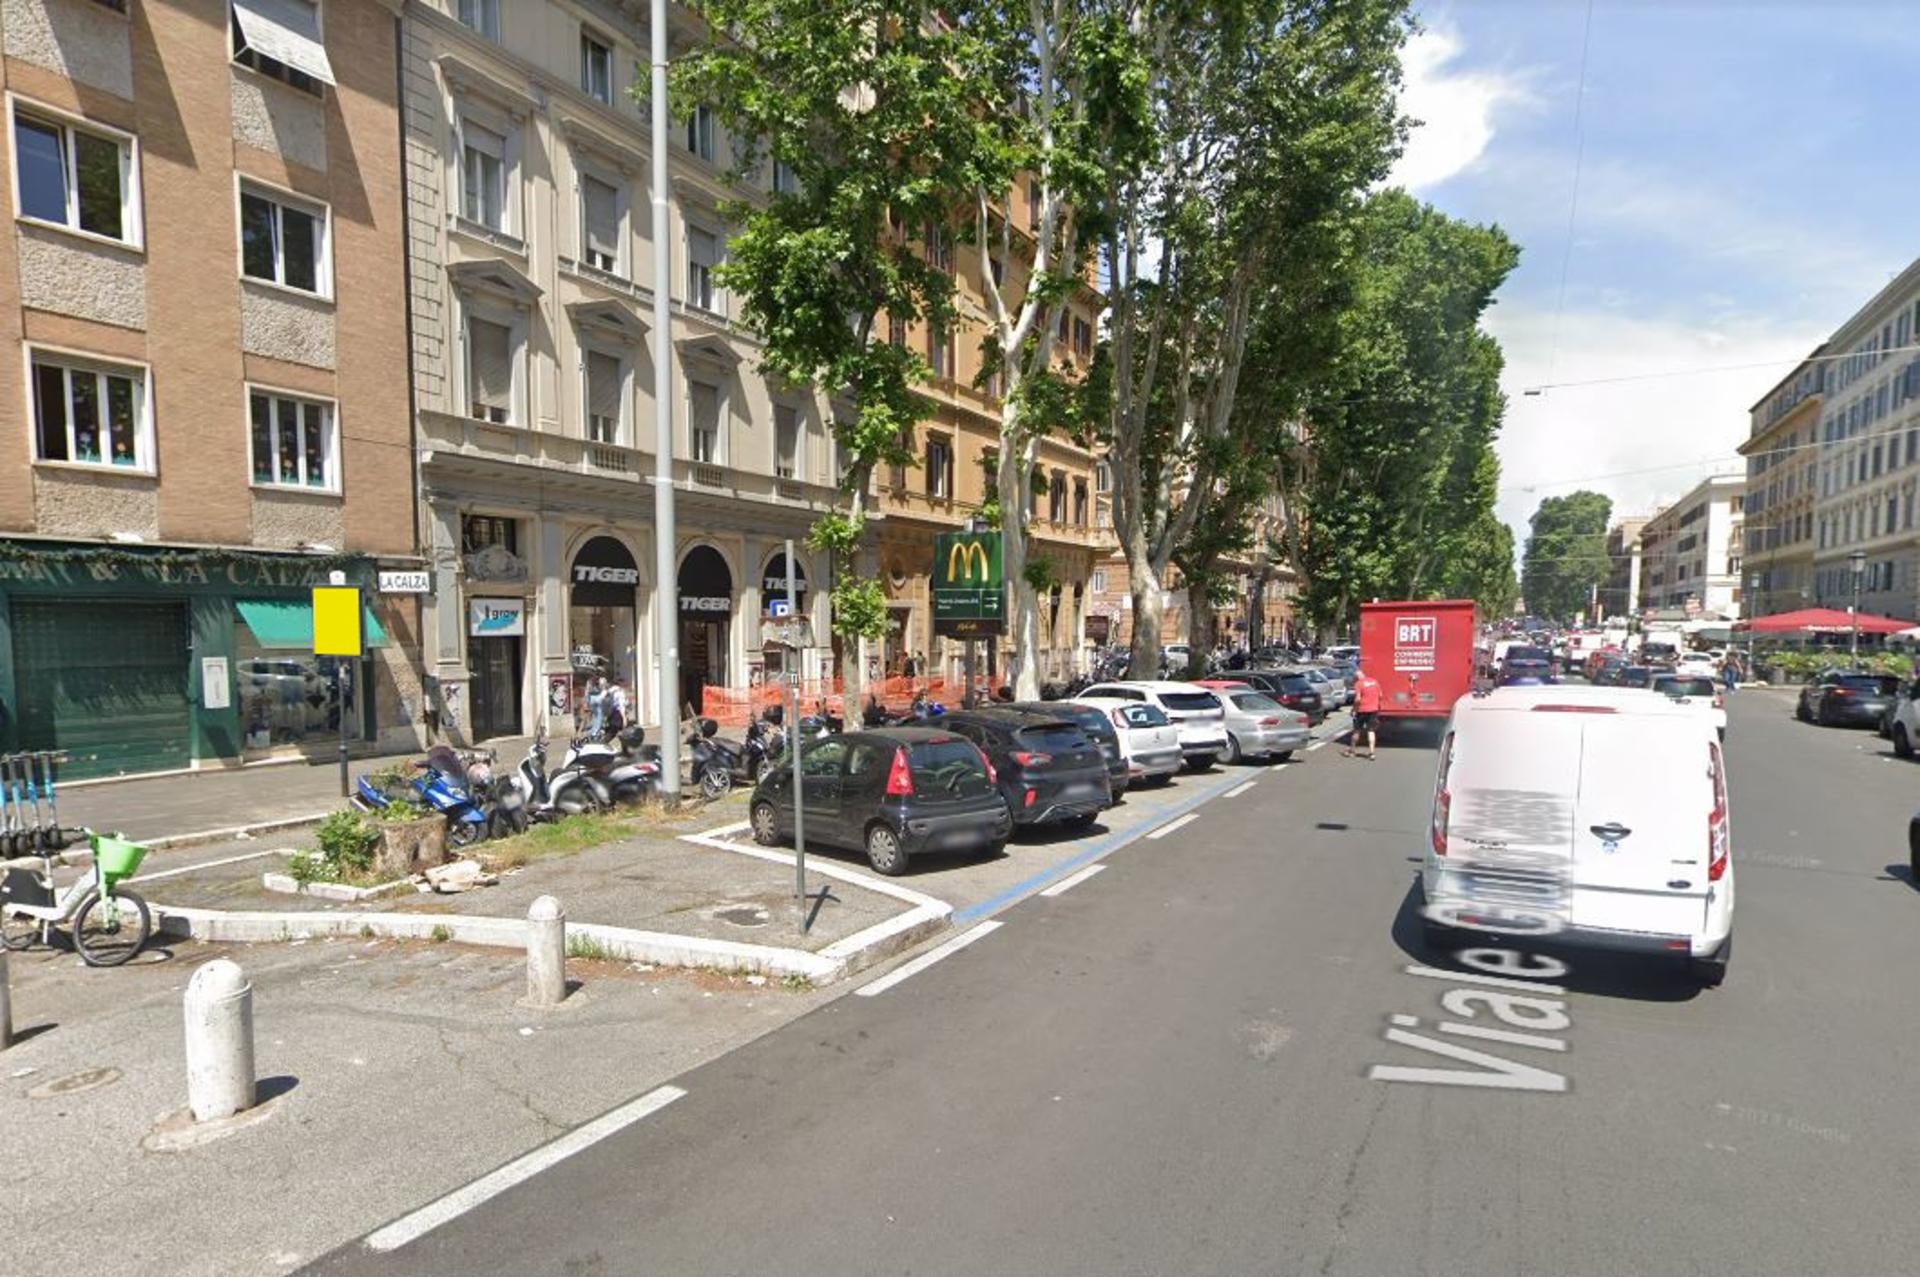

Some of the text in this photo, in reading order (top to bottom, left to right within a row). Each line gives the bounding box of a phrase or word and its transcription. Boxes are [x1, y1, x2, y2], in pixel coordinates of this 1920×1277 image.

[380, 573, 429, 590] LA CALZA
[574, 565, 639, 584] TIGER
[680, 596, 731, 611] TIGER
[1399, 624, 1431, 642] BRT
